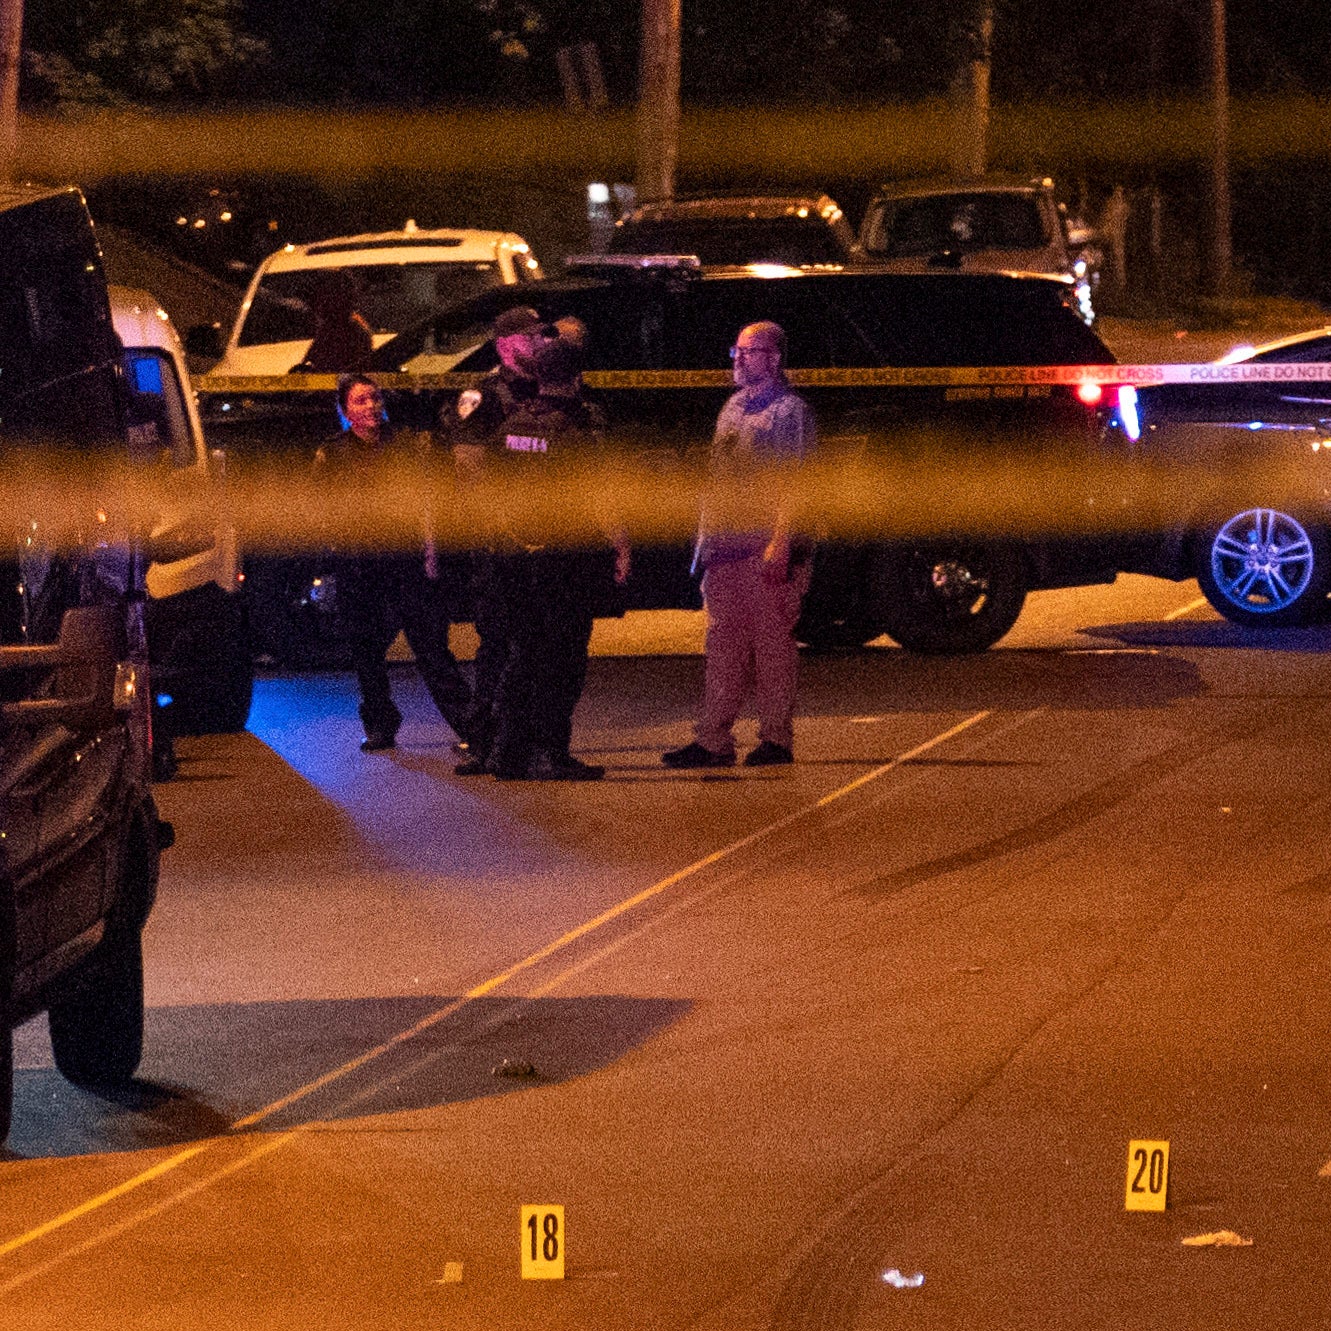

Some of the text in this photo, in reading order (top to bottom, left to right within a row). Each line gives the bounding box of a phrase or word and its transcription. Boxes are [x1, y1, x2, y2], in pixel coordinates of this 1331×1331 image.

[1117, 368, 1164, 379] CROSS
[1190, 367, 1239, 379] POLICE
[1243, 367, 1271, 378] LINE
[1274, 366, 1293, 378] DO
[1297, 366, 1324, 377] NOT
[1131, 1148, 1164, 1195] 20
[527, 1212, 559, 1262] 18
